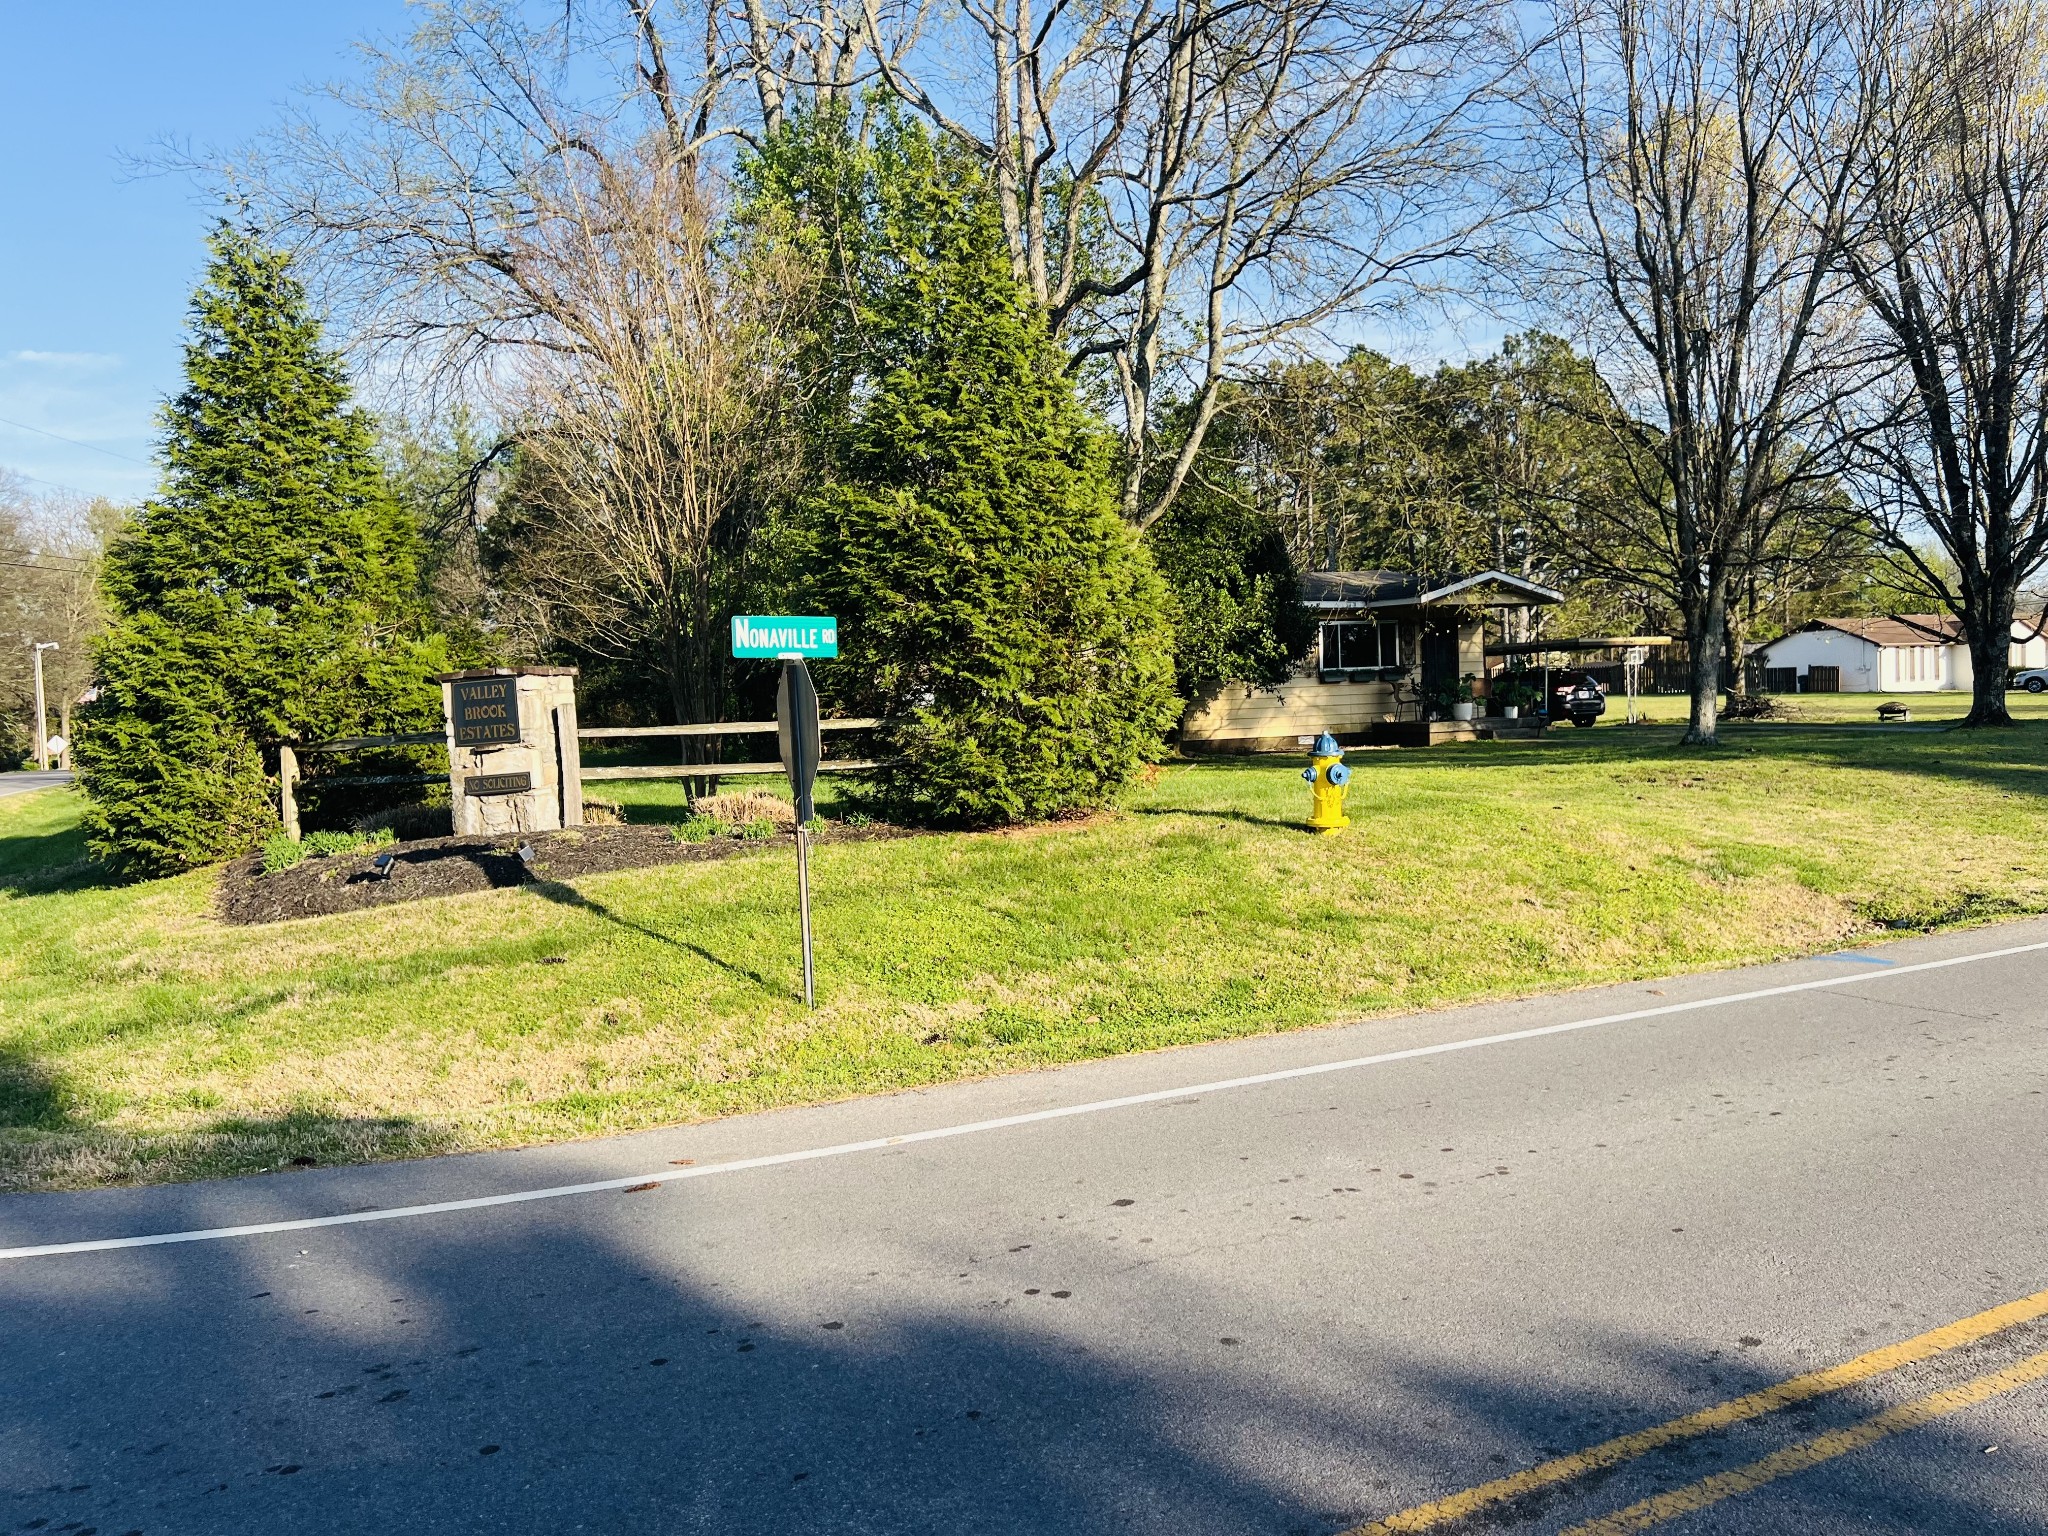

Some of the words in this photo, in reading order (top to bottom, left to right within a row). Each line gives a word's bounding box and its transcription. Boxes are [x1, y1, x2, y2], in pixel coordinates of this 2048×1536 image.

[735, 618, 818, 649] NONAVILLE
[822, 628, 835, 644] RD
[460, 684, 507, 700] VALLEY
[464, 704, 507, 720] BROOK
[460, 723, 516, 740] ESTATES
[469, 780, 480, 791] NO
[482, 776, 527, 790] SOLICITING
